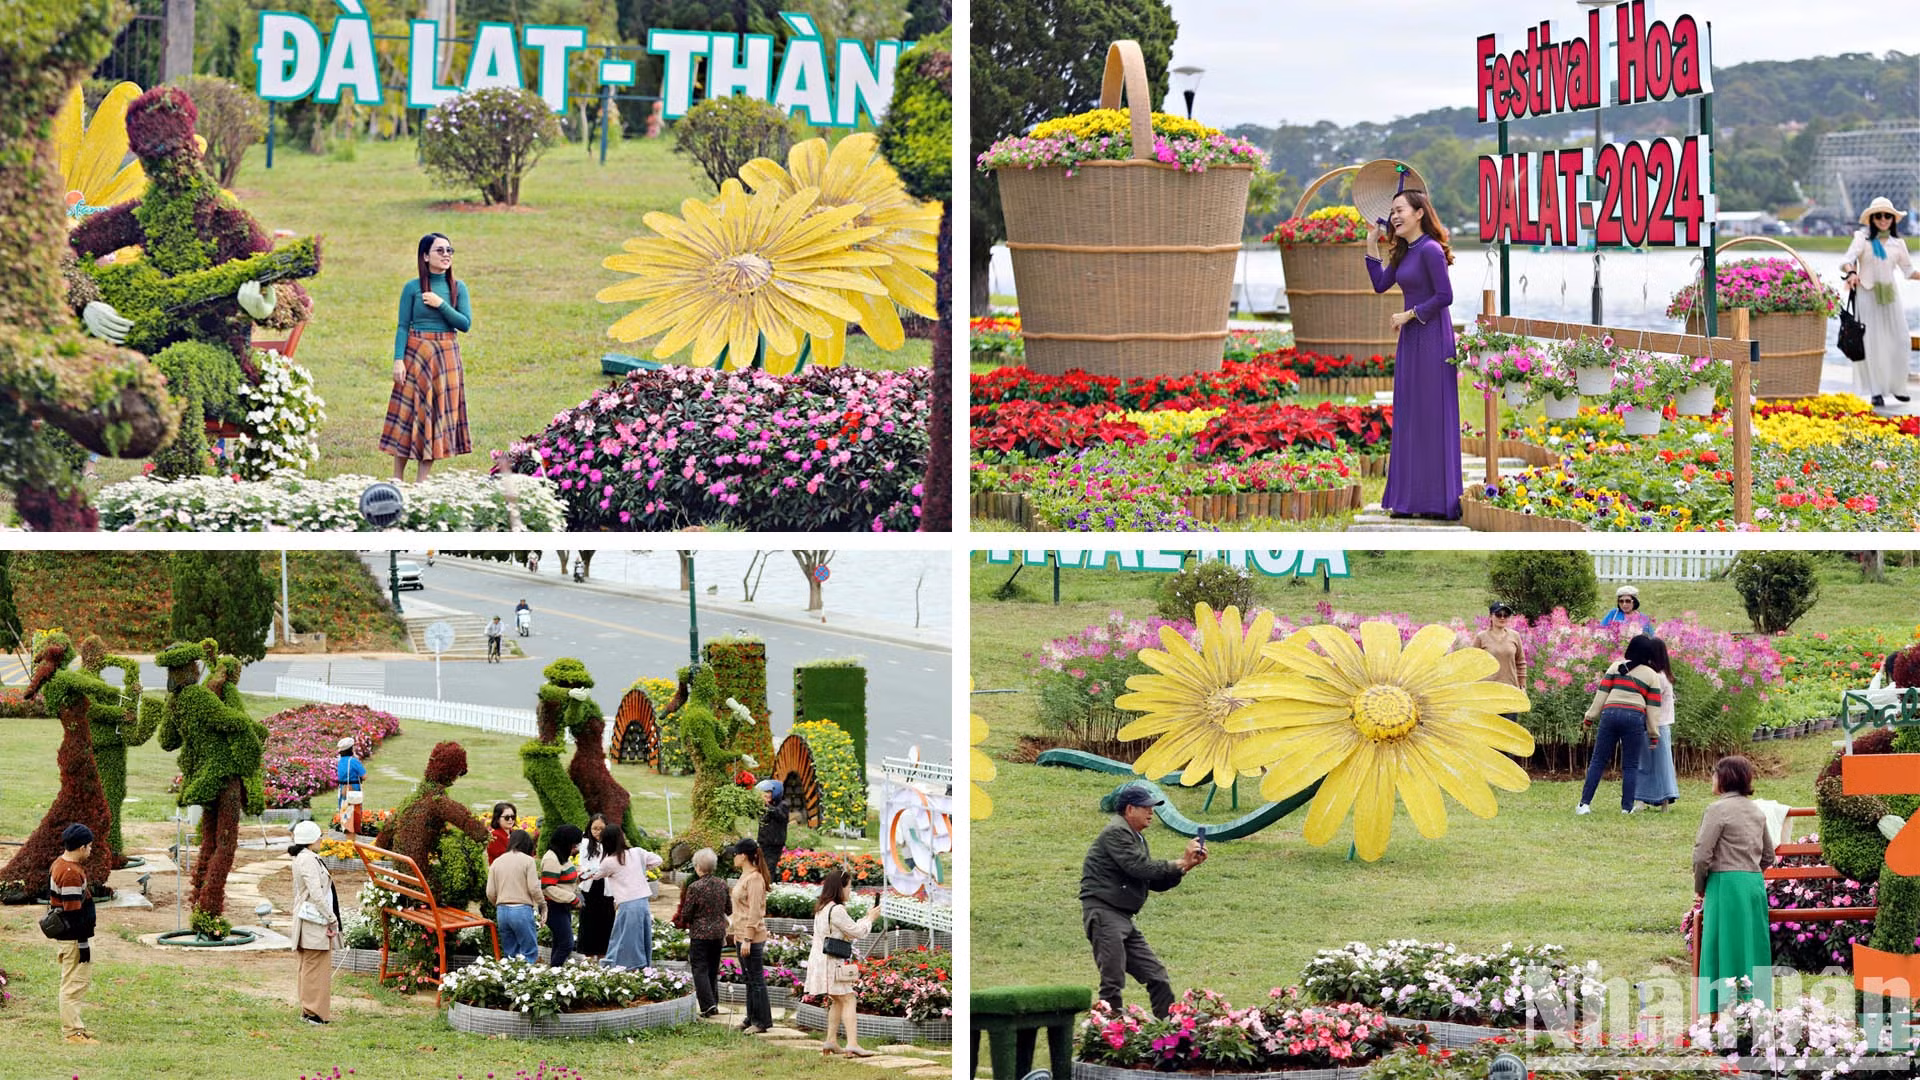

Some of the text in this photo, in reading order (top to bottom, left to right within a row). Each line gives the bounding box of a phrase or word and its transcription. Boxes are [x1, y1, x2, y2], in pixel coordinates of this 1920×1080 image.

[254, 0, 384, 105] ĐÀ
[1476, 0, 1704, 123] Festival Hoa
